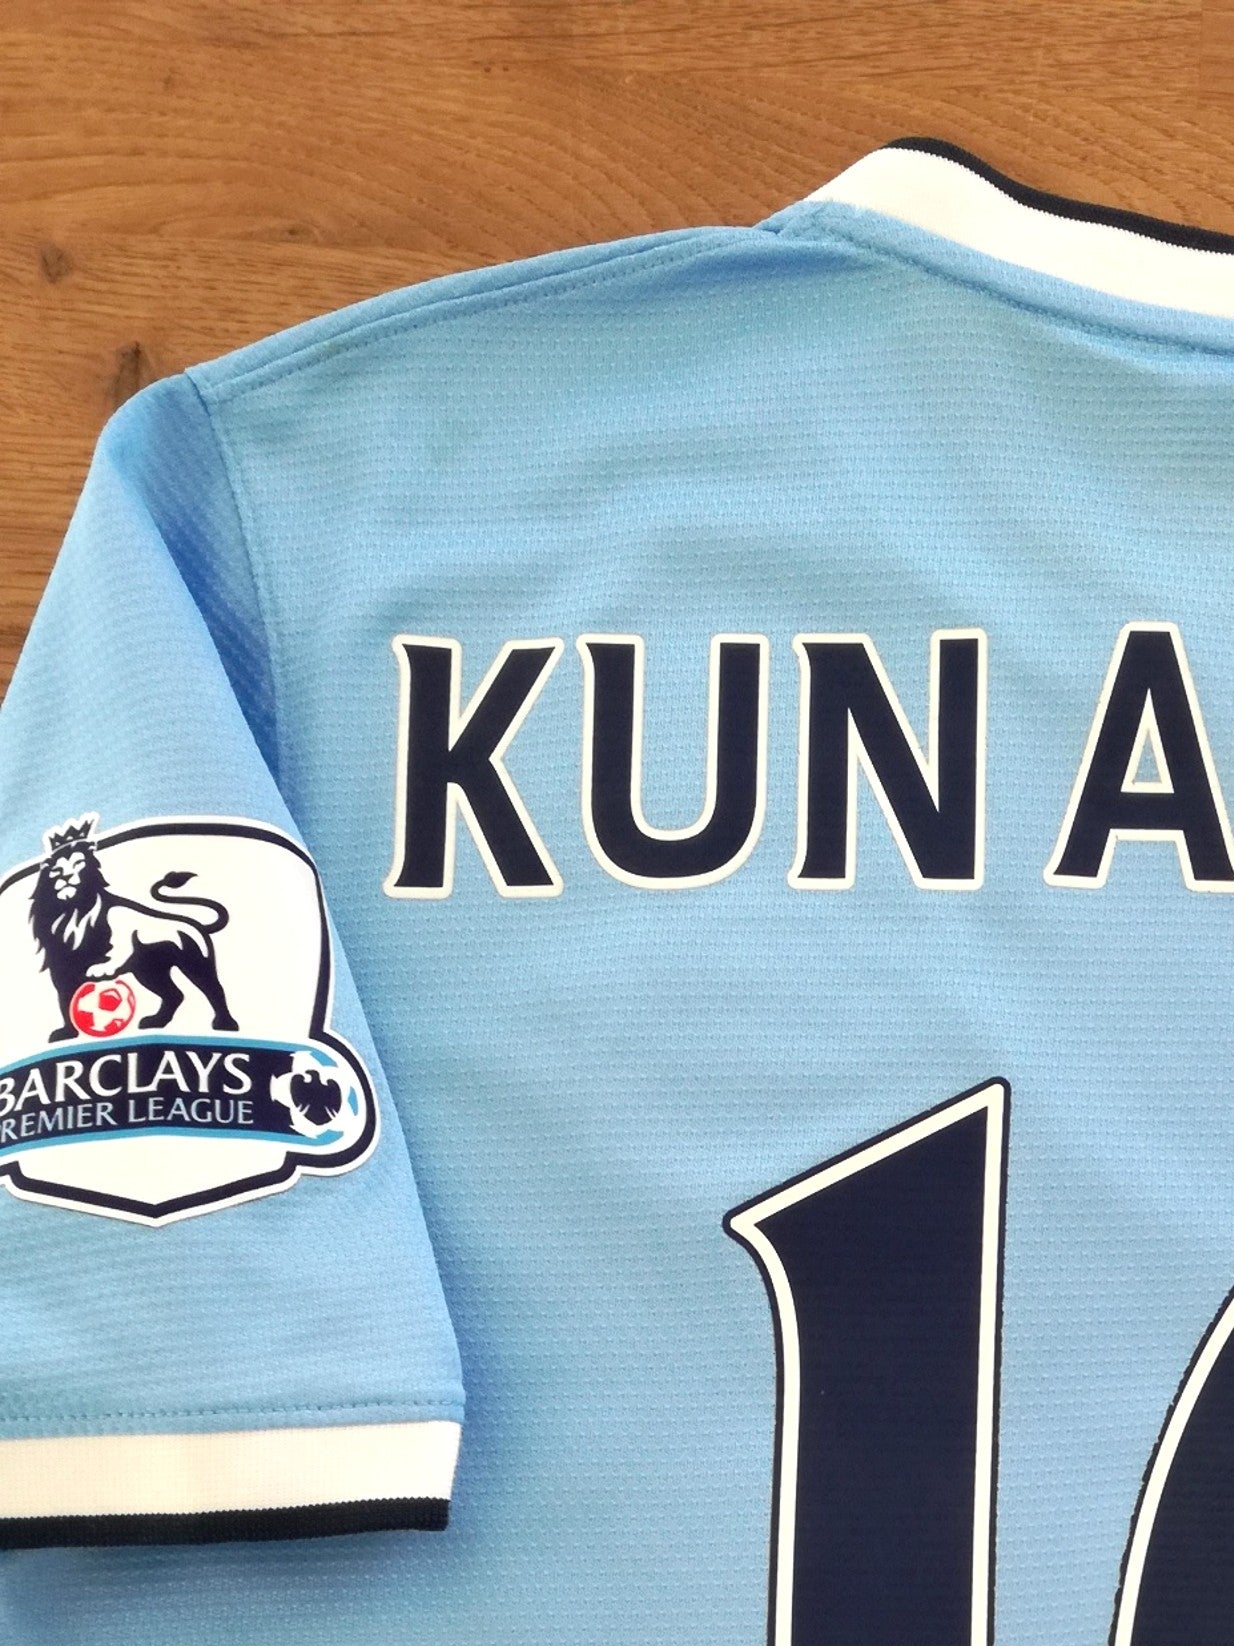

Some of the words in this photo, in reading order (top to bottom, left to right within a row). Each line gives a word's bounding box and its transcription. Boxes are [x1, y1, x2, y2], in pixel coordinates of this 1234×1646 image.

[383, 629, 987, 898] KUN
[0, 1102, 118, 1143] REMIER
[128, 1097, 254, 1125] LEAGUE
